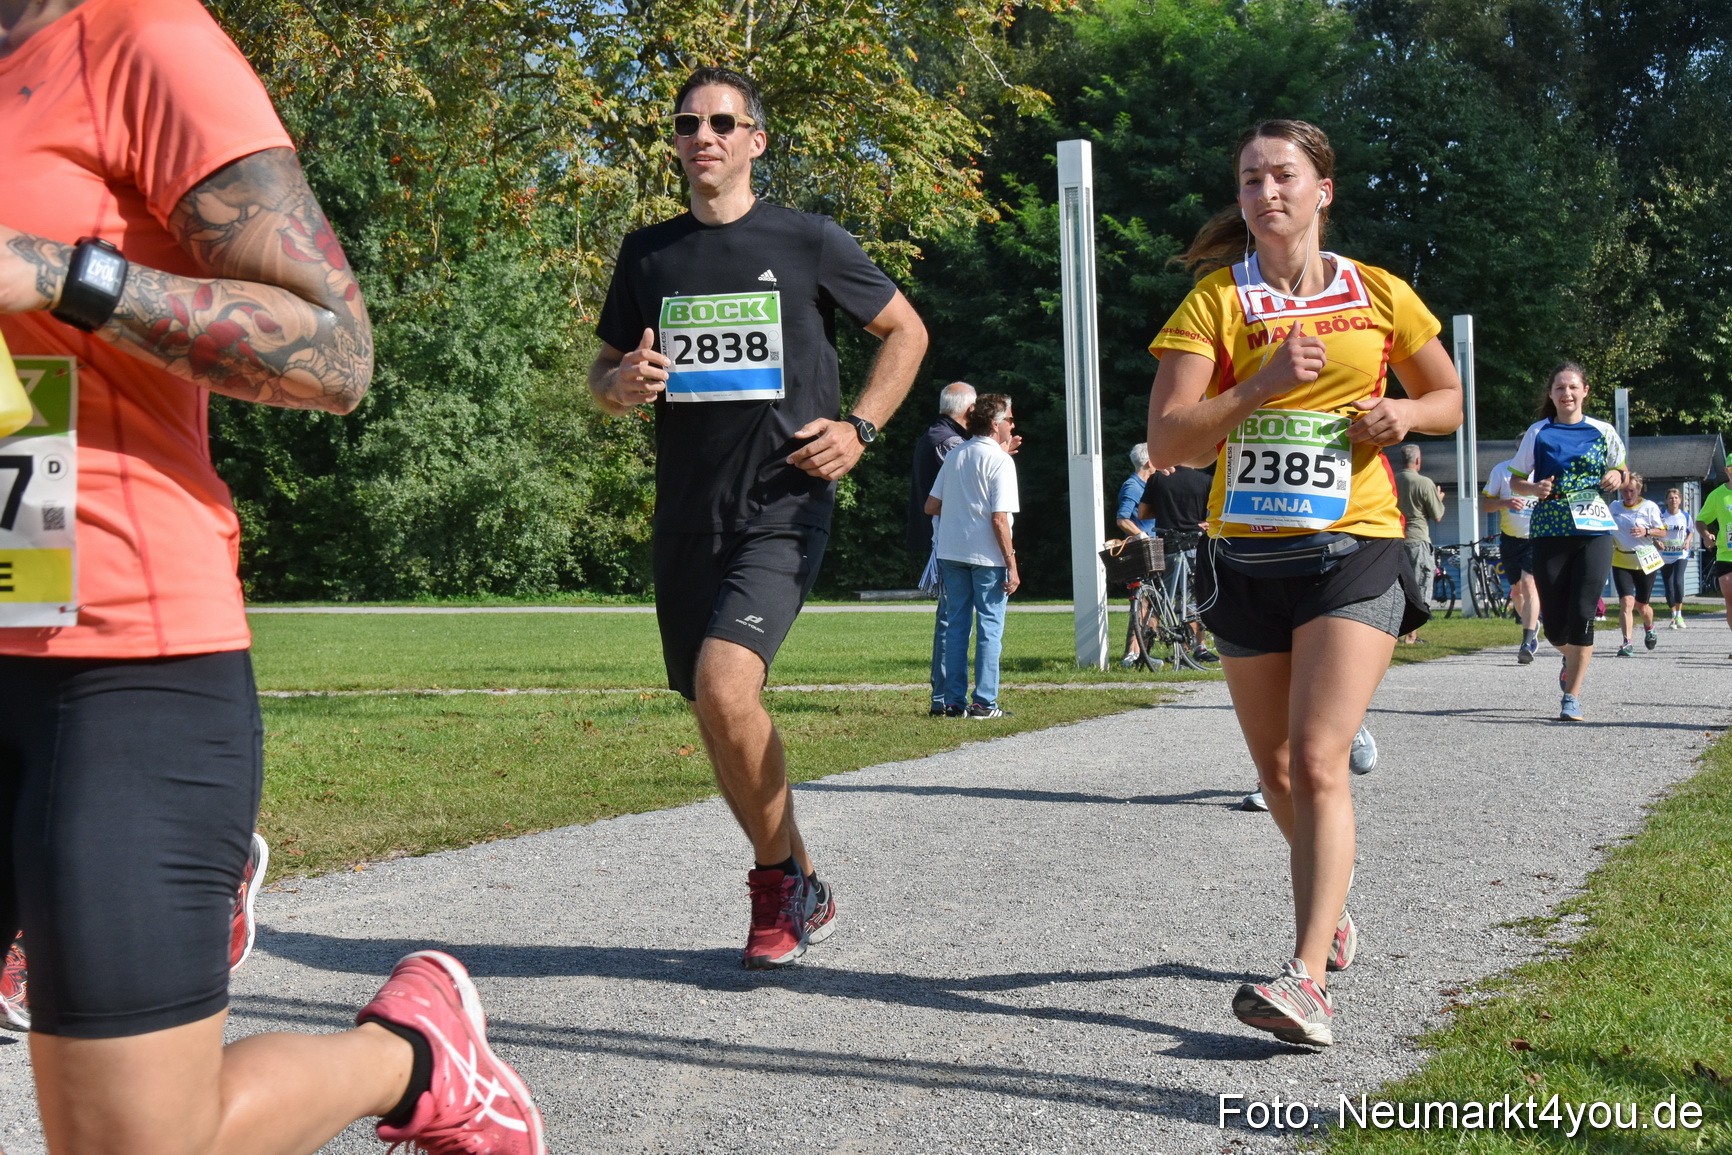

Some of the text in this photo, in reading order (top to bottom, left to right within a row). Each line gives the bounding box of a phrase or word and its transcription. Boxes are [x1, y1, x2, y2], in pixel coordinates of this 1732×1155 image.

[667, 297, 770, 325] BOCK
[673, 331, 769, 365] 2838
[1246, 315, 1379, 351] MAX BÖGL
[1236, 414, 1342, 446] BOCK
[48, 460, 61, 475] D
[1237, 450, 1336, 489] 2385
[1251, 496, 1313, 514] TANJA
